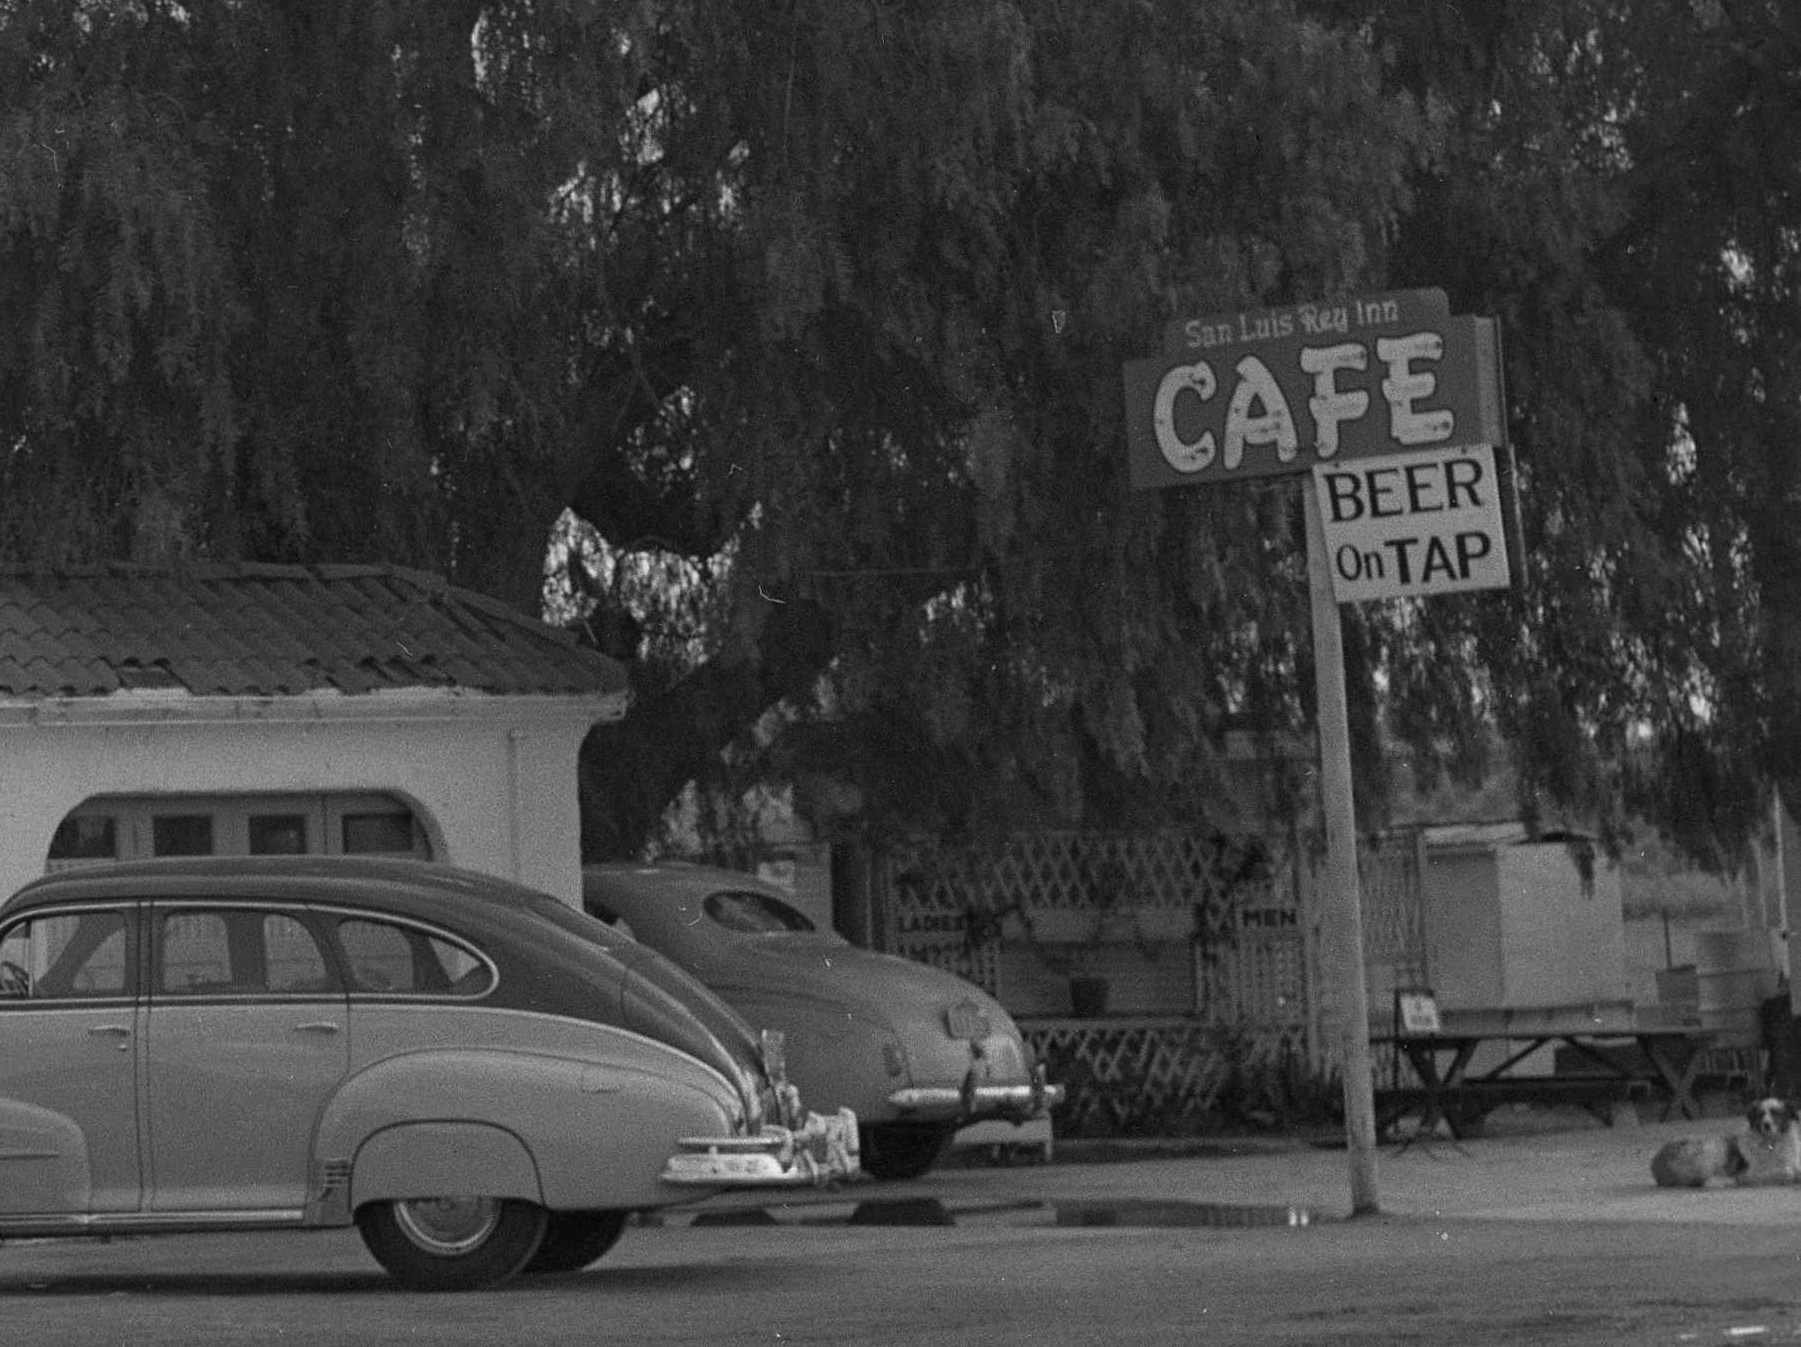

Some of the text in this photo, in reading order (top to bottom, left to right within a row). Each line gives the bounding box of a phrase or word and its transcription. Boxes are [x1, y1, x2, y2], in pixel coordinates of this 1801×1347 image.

[1184, 299, 1399, 349] San Luis Rey Inn
[1153, 332, 1454, 473] CAFE
[1322, 457, 1483, 523] BEER
[1335, 530, 1491, 585] On TAP
[1242, 908, 1297, 927] MEN
